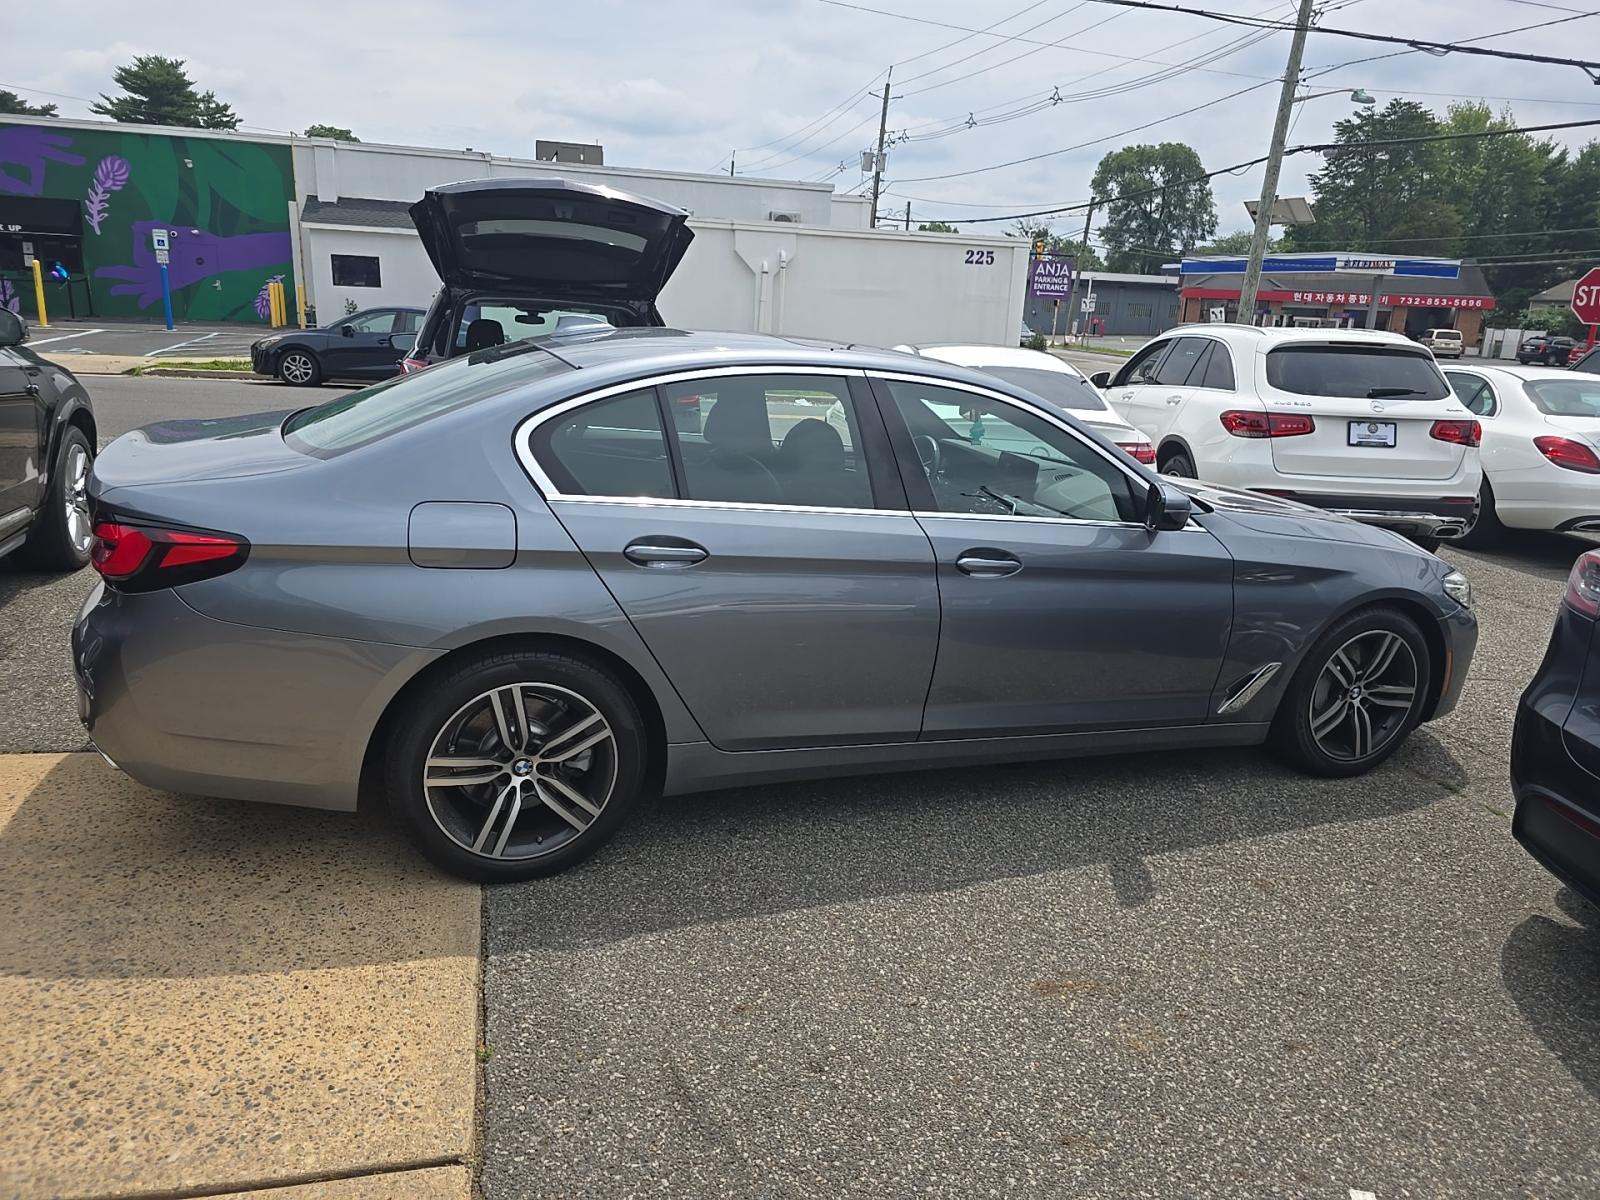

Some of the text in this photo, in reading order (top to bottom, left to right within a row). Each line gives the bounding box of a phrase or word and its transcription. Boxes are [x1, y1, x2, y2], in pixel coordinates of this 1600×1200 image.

[7, 224, 22, 232] UP
[965, 249, 995, 265] 225
[1035, 262, 1070, 277] ANJA
[1034, 276, 1063, 284] PARKING
[1033, 283, 1068, 291] ENTRANCE
[1576, 285, 1600, 307] ST
